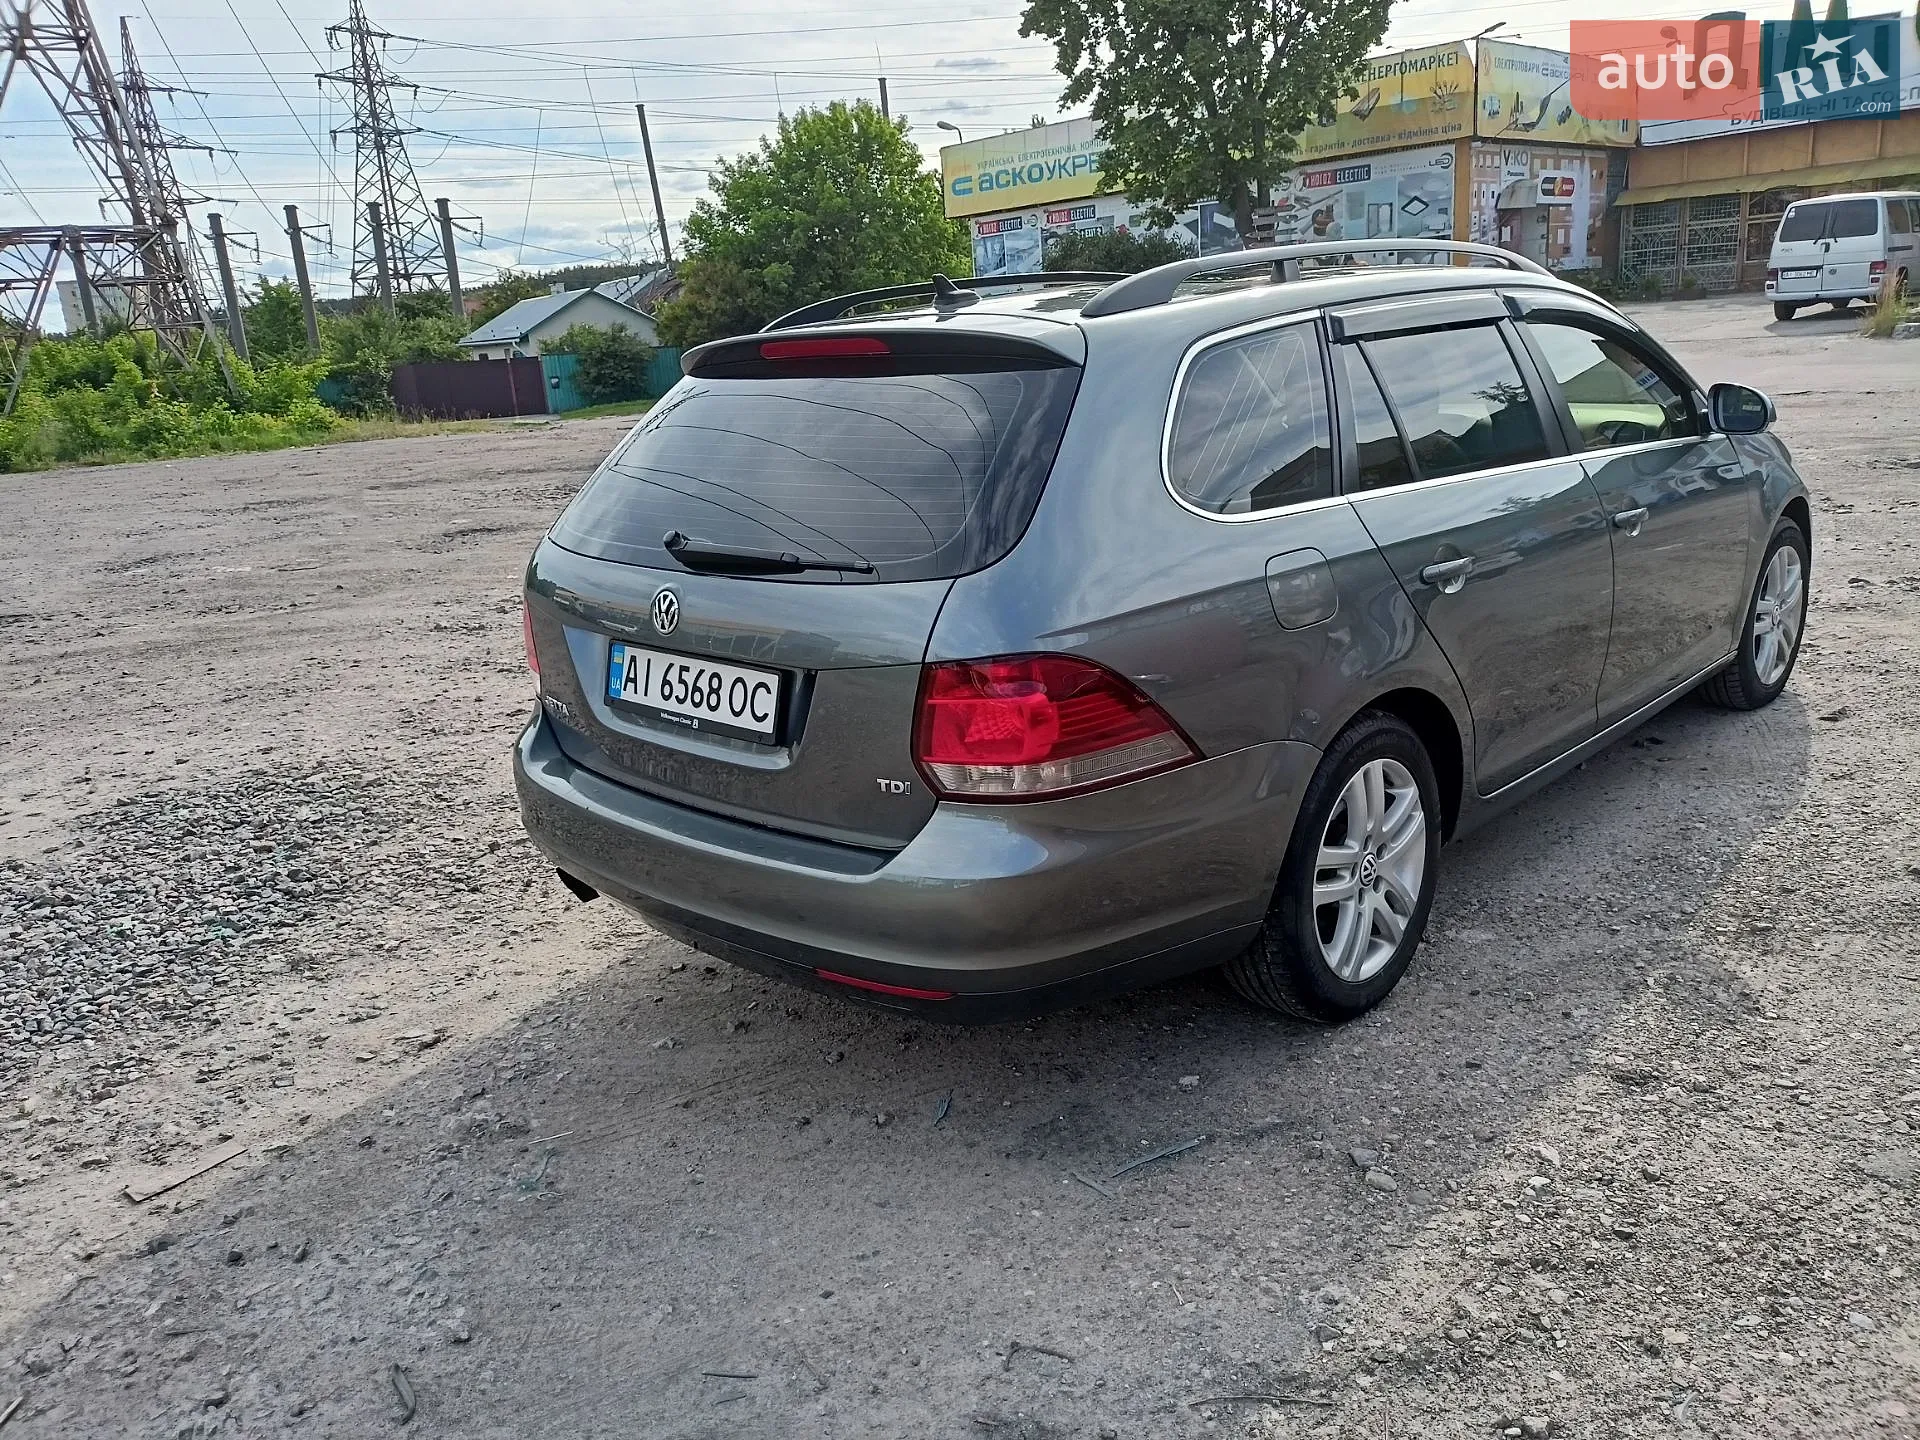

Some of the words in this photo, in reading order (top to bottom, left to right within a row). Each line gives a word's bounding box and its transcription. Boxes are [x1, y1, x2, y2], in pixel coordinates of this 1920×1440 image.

[1310, 138, 1345, 154] гарантія
[1351, 134, 1390, 149] доставка
[1398, 126, 1438, 141] відмінна
[1441, 122, 1461, 136] ціна
[977, 154, 1015, 170] УКРАЇНСЬКА
[1018, 144, 1077, 163] ЕЛЕКТРОТЕХНІЧНА
[611, 678, 621, 690] UA
[623, 655, 651, 697] AI
[660, 663, 722, 712] 6568
[729, 676, 772, 723] OC
[876, 778, 911, 795] TDI
